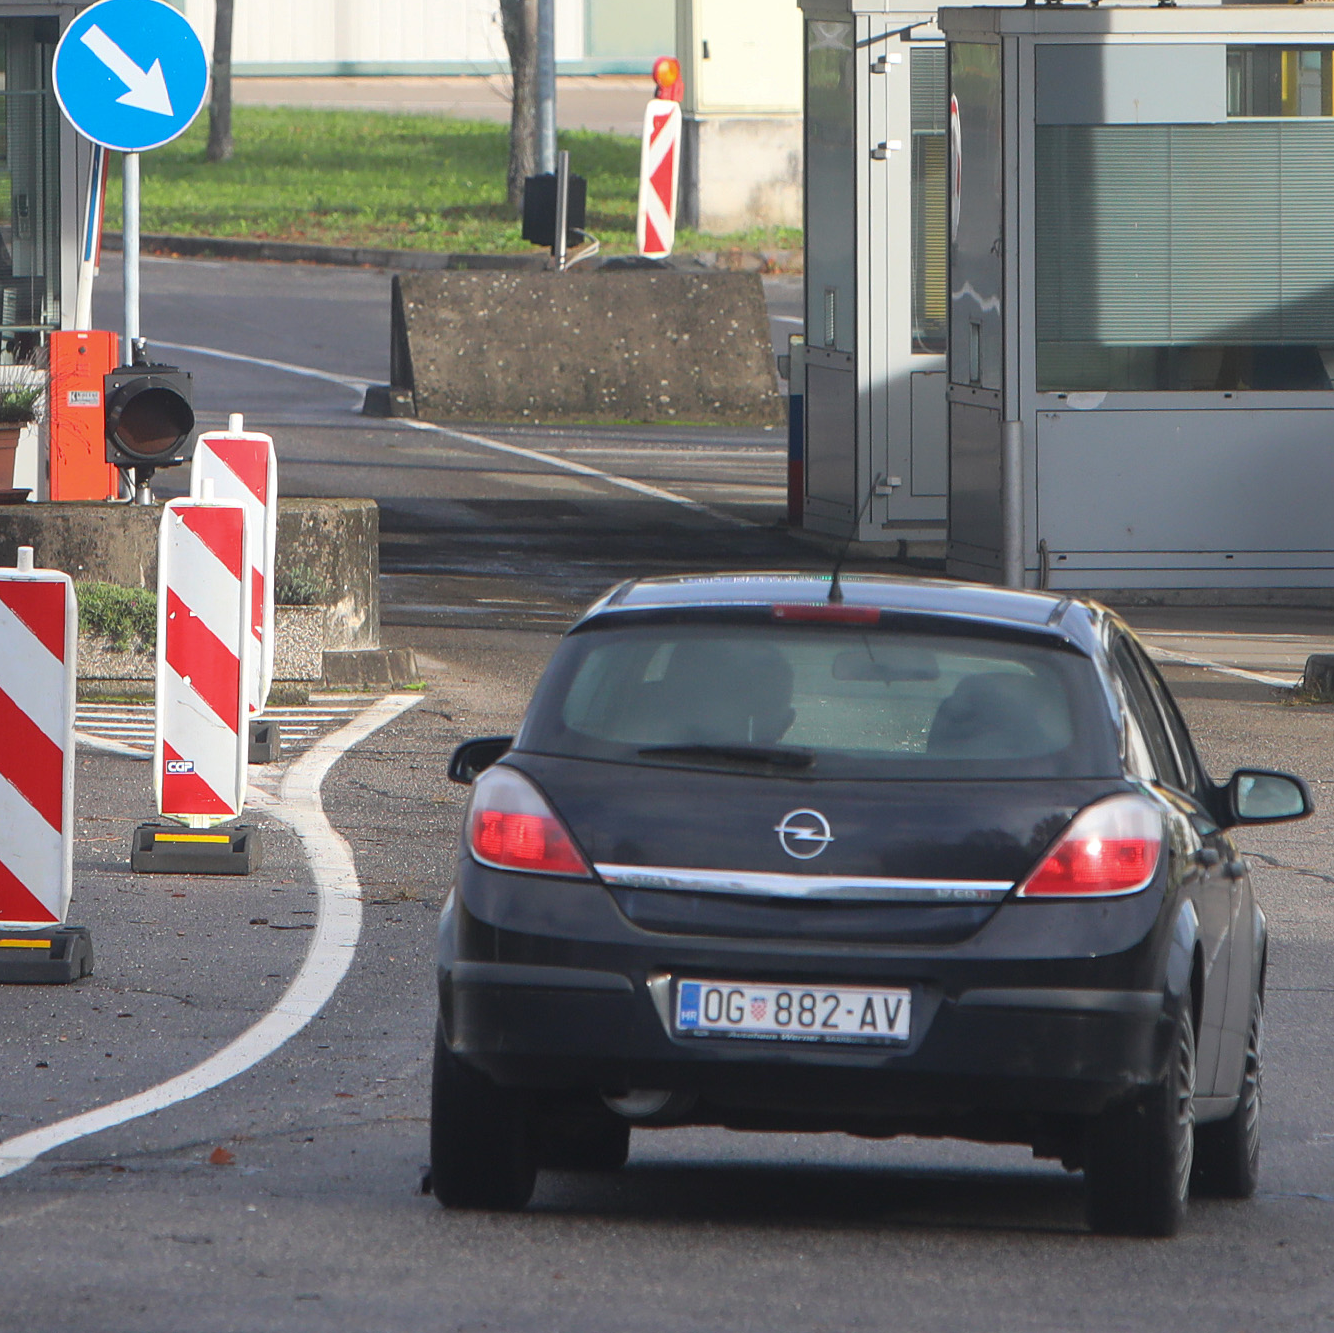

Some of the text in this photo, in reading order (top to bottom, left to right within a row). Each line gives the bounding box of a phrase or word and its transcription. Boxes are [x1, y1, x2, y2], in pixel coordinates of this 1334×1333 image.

[168, 761, 193, 773] CGP
[681, 1010, 697, 1022] HR
[704, 989, 903, 1032] OG 882-AV
